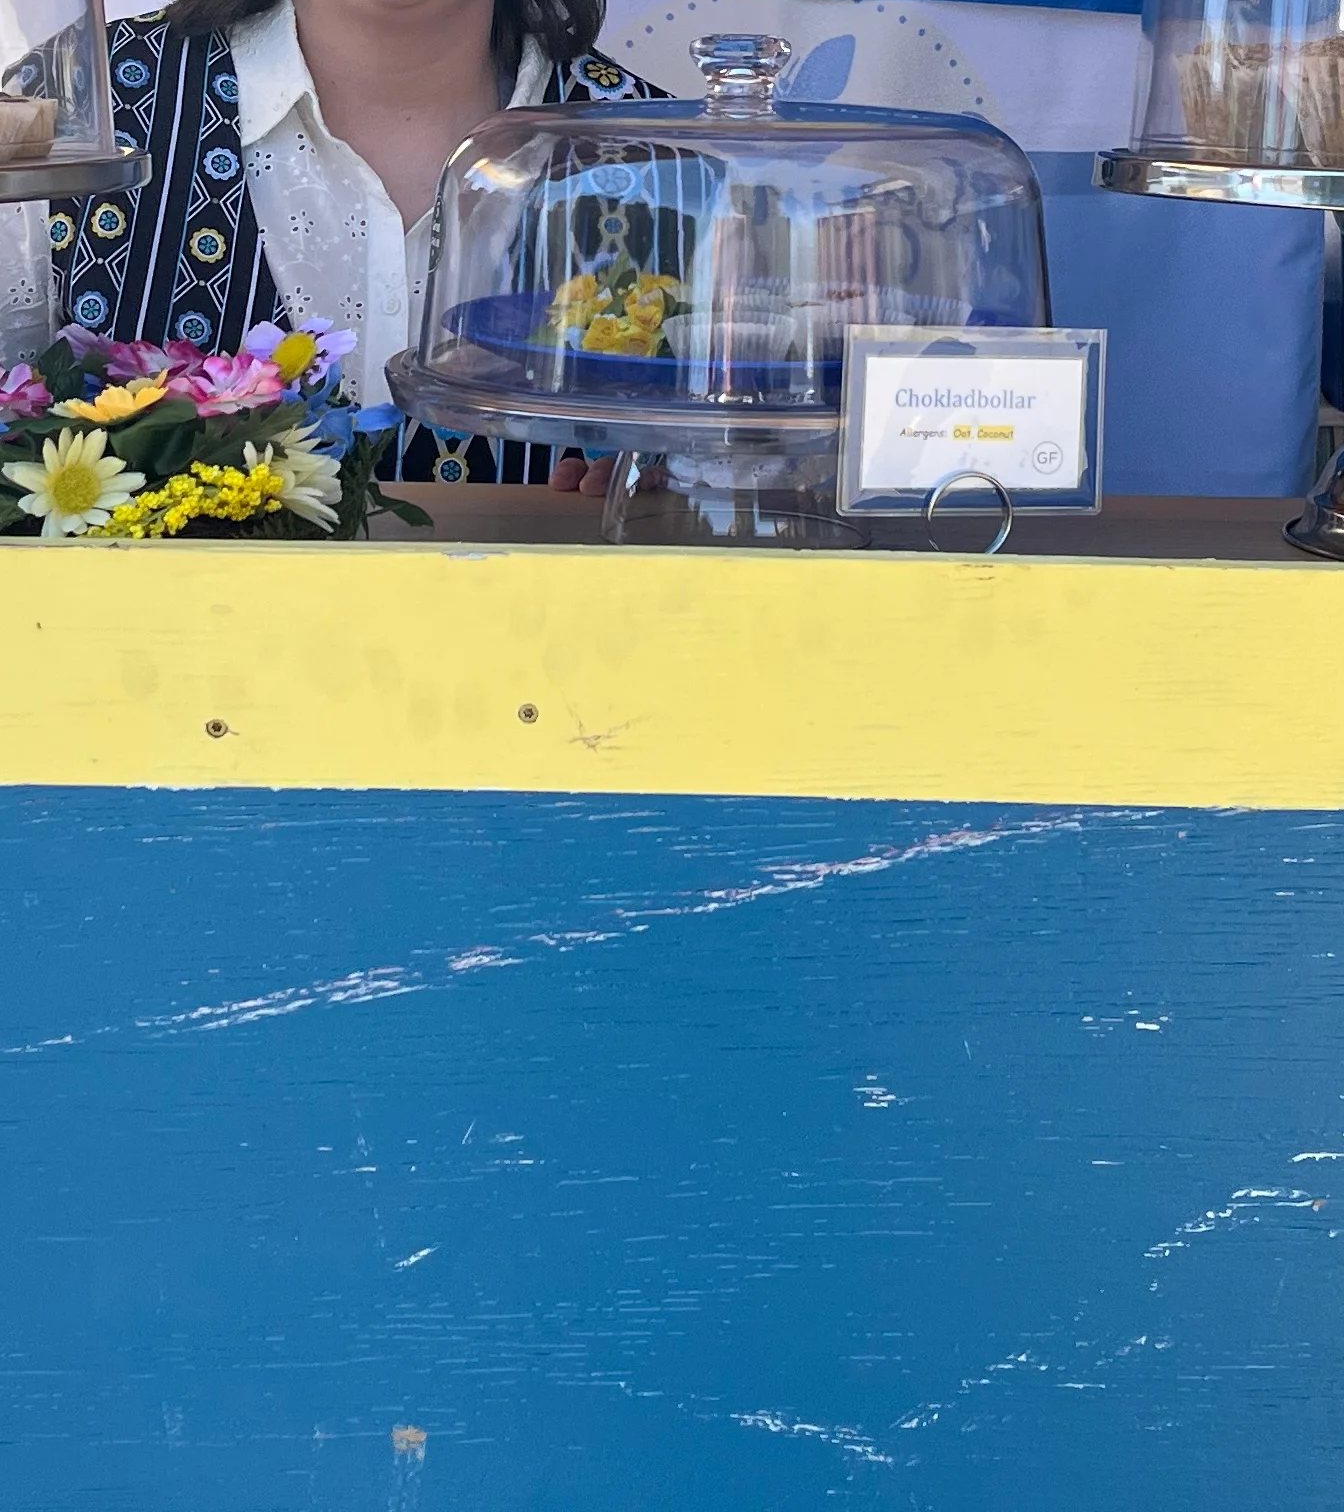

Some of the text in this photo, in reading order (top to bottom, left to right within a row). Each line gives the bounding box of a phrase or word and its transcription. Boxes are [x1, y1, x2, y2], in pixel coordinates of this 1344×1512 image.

[895, 388, 1037, 410] Chokladbollar
[977, 428, 1015, 439] Coconut
[1036, 451, 1059, 465] GF
